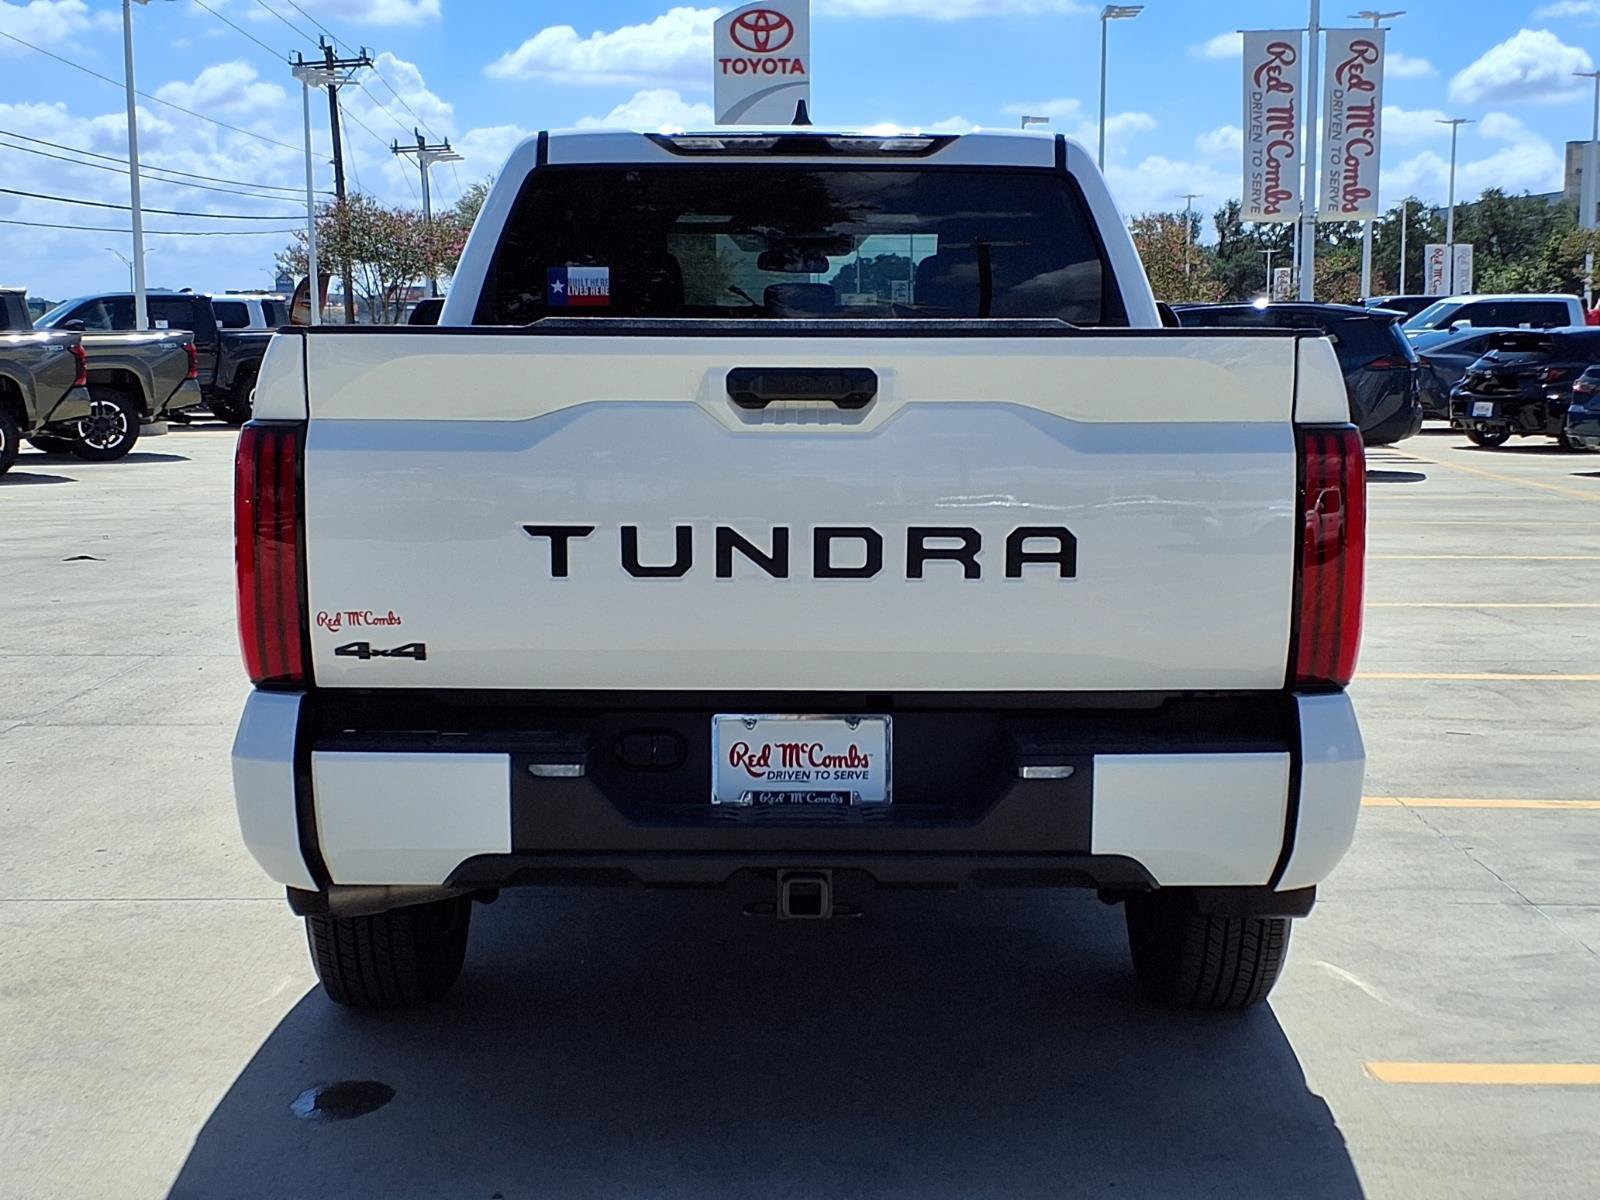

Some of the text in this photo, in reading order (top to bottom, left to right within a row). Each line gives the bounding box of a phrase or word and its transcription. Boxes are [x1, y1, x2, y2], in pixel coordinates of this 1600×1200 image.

[719, 58, 805, 75] TOYOTA
[1254, 42, 1296, 215] Red McCombs
[1335, 40, 1379, 213] Red McCombs
[1251, 91, 1263, 214] DRIVEN TO SERVE
[1328, 89, 1344, 212] DRIVEN TO SERVE
[567, 286, 610, 296] LIVES HERE
[522, 525, 1078, 579] TUNDRA
[316, 610, 402, 632] Red McCombs
[334, 641, 427, 661] 4x4
[729, 741, 869, 778] Red McCombs
[767, 770, 869, 780] DRIVEN TO SERVE
[759, 792, 843, 804] Red McCombs
